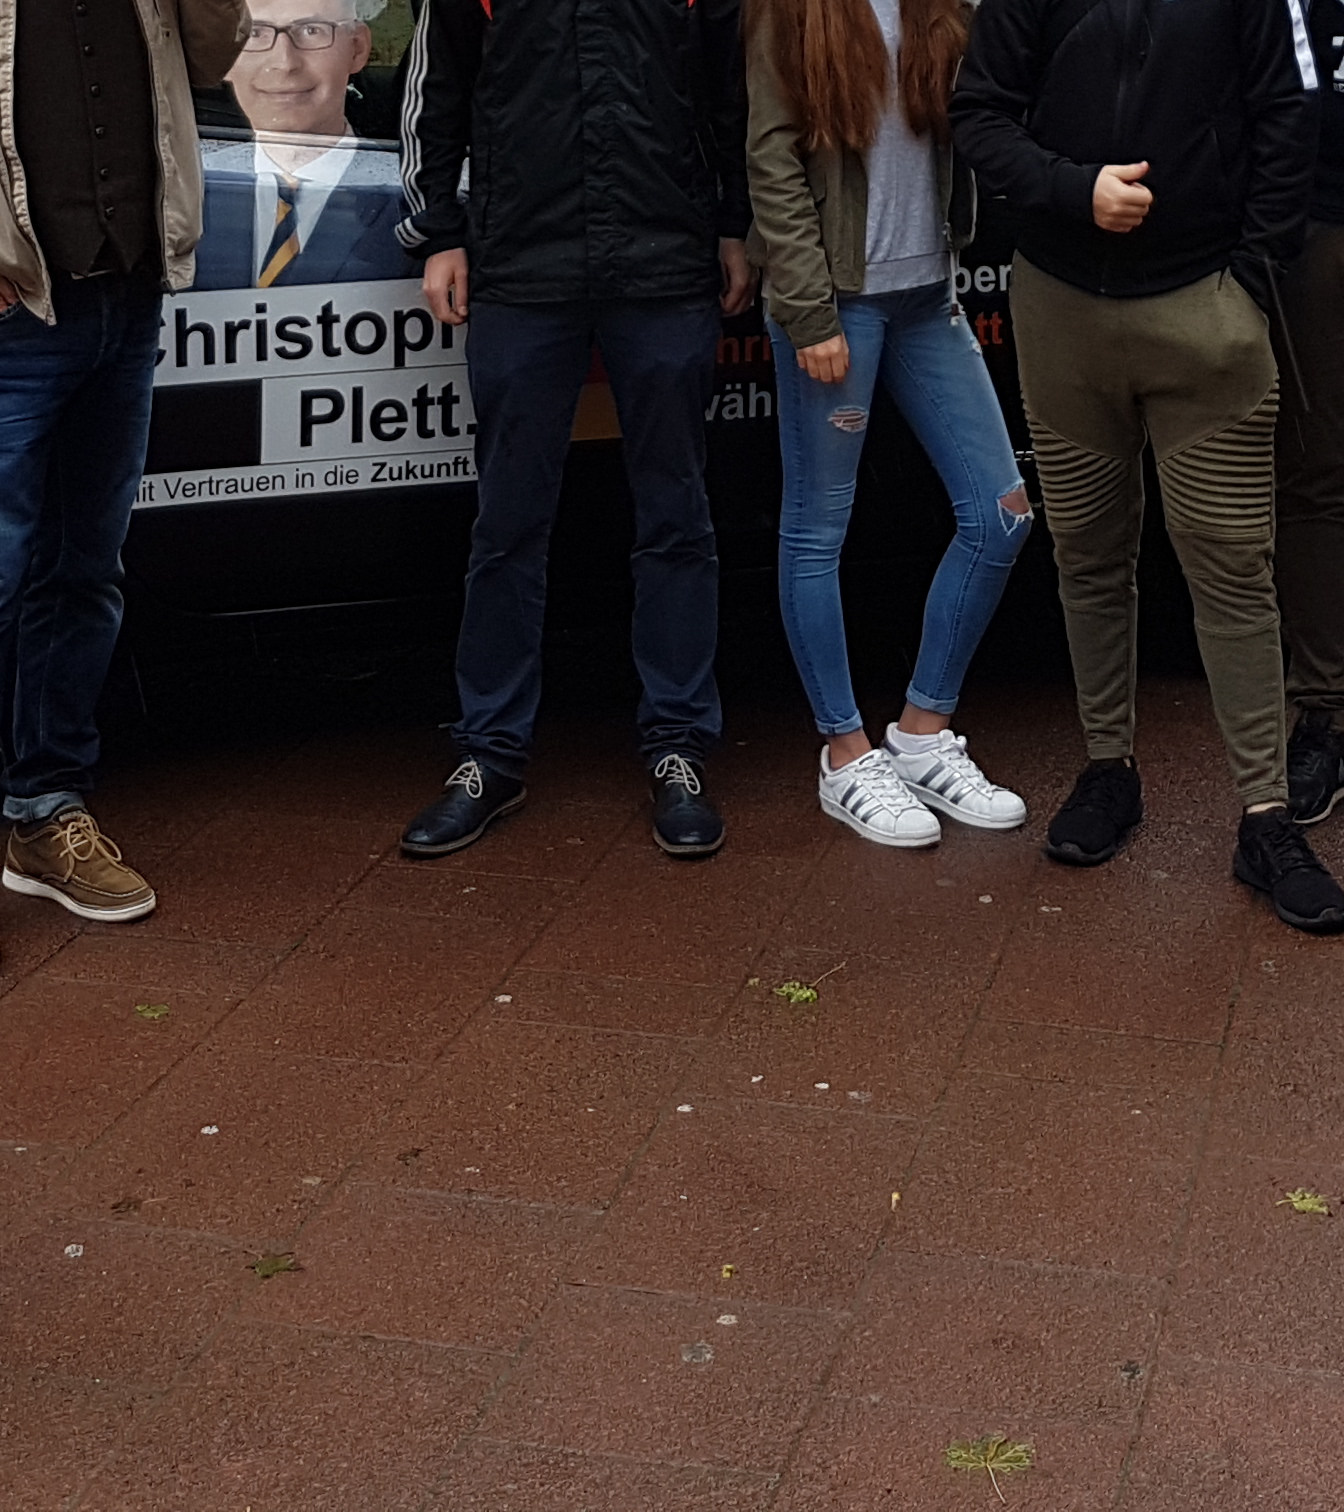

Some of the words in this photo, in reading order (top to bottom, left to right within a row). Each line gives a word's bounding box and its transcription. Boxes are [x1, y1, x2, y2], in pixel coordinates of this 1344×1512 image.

[155, 291, 455, 369] hristop
[299, 381, 478, 449] Plett.
[135, 479, 155, 503] it
[163, 471, 286, 500] Vertrauen
[295, 467, 315, 489] in
[323, 464, 360, 487] die
[370, 456, 477, 483] Zukunft.
